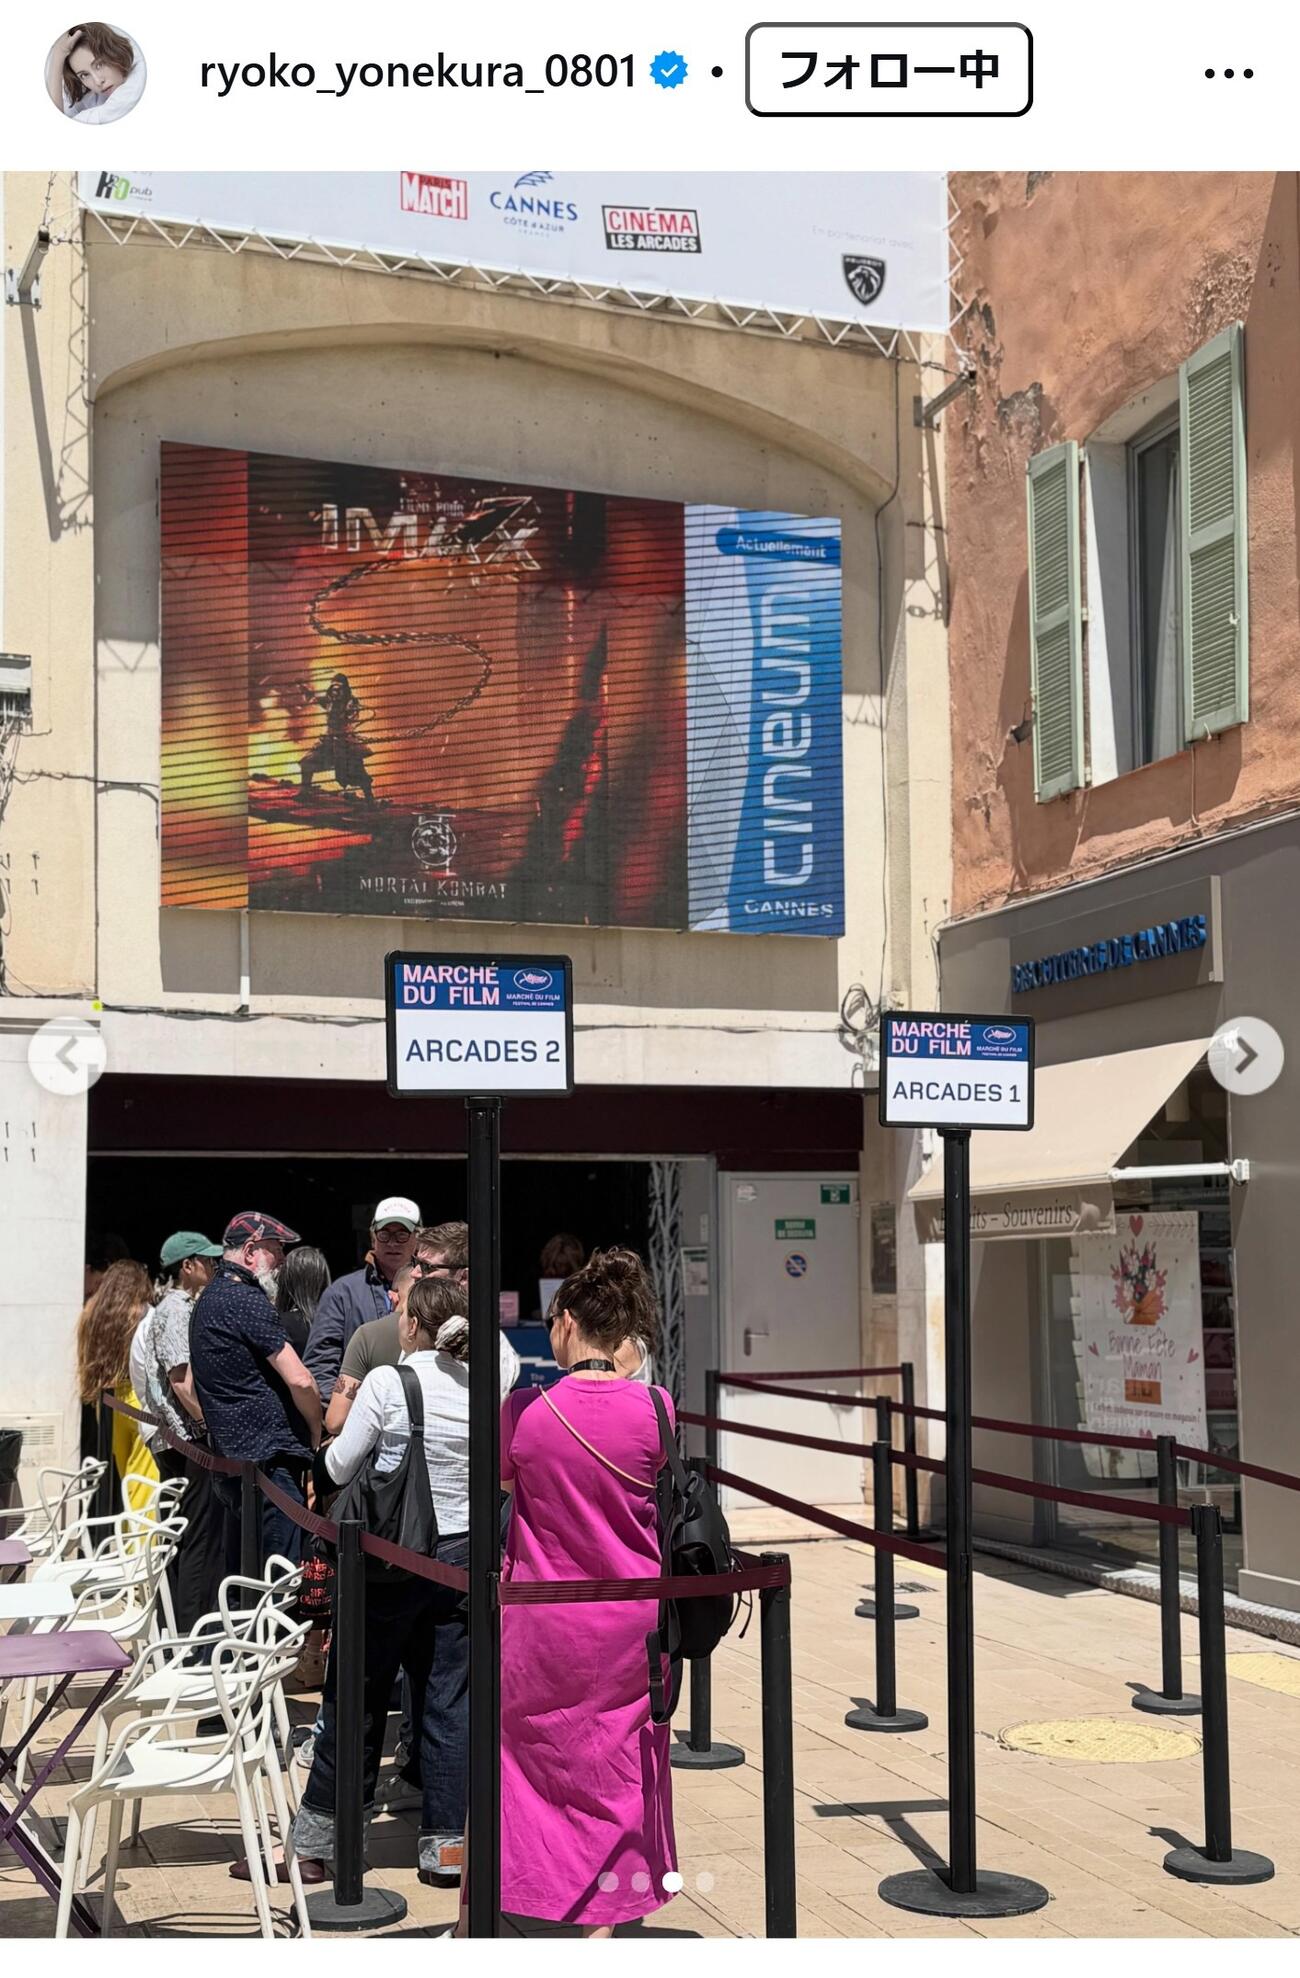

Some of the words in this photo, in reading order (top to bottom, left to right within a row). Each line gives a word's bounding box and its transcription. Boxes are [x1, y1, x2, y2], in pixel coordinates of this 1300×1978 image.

[402, 173, 467, 219] MATCH
[489, 190, 579, 221] CANNES
[610, 233, 635, 248] LES
[636, 235, 698, 251] ARCADES
[322, 500, 542, 571] IMAX
[736, 535, 828, 559] Actuellement
[761, 584, 814, 886] cineum
[744, 899, 834, 919] CANNES
[1132, 914, 1208, 961] CANNES
[403, 961, 500, 985] MARCHÉ
[403, 985, 437, 1005] DU
[449, 986, 500, 1006] FILM
[891, 1020, 972, 1039] MARCHÉ
[406, 1039, 538, 1062] ARCADES
[545, 1040, 561, 1062] 2
[891, 1039, 919, 1054] DU
[929, 1040, 972, 1055] FILM
[892, 1081, 1003, 1102] ARCADES
[1009, 1085, 1021, 1102] 1
[1002, 1200, 1073, 1228] Souvenirs
[1108, 1330, 1142, 1354] Bonne
[1147, 1327, 1176, 1358] Fête
[1122, 1354, 1162, 1379] Maman
